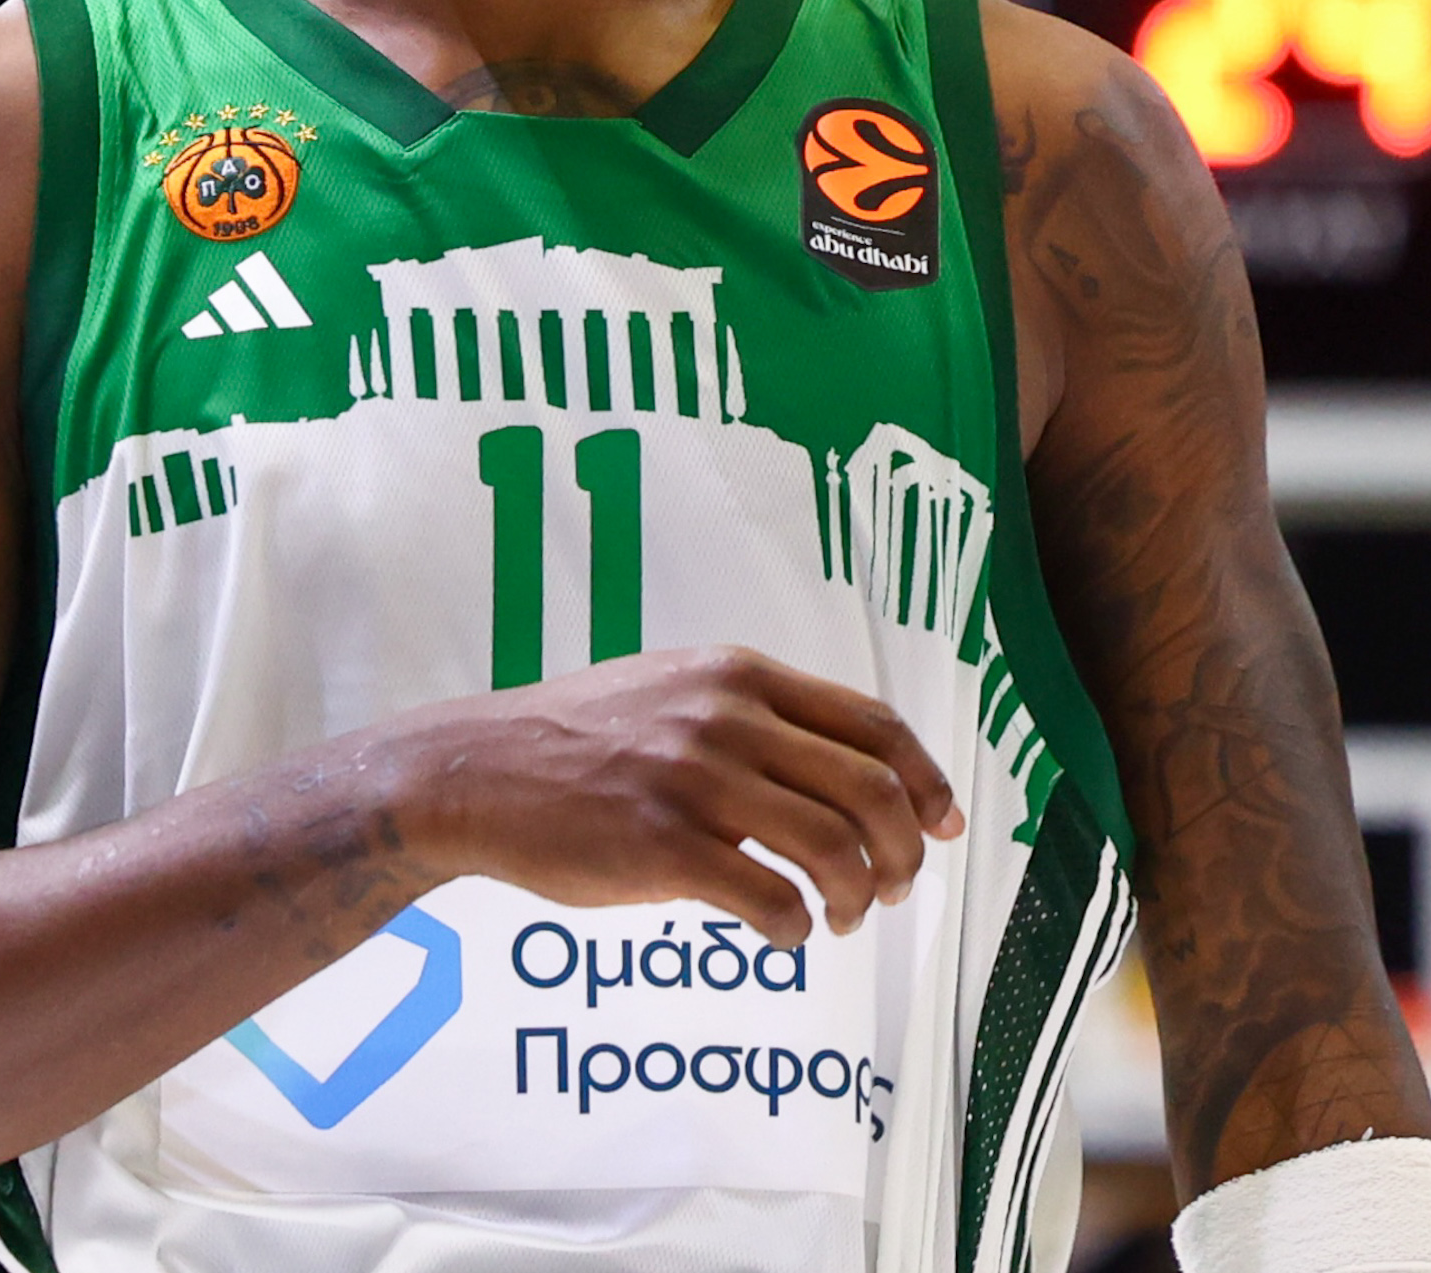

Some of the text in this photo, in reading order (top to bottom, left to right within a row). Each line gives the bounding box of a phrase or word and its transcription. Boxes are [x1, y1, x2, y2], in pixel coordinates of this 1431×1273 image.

[810, 233, 929, 275] abu dhabi
[811, 220, 873, 246] experience
[479, 425, 643, 690] 11
[511, 921, 806, 1008] Ομάδα
[516, 1027, 894, 1143] Προσφορς
